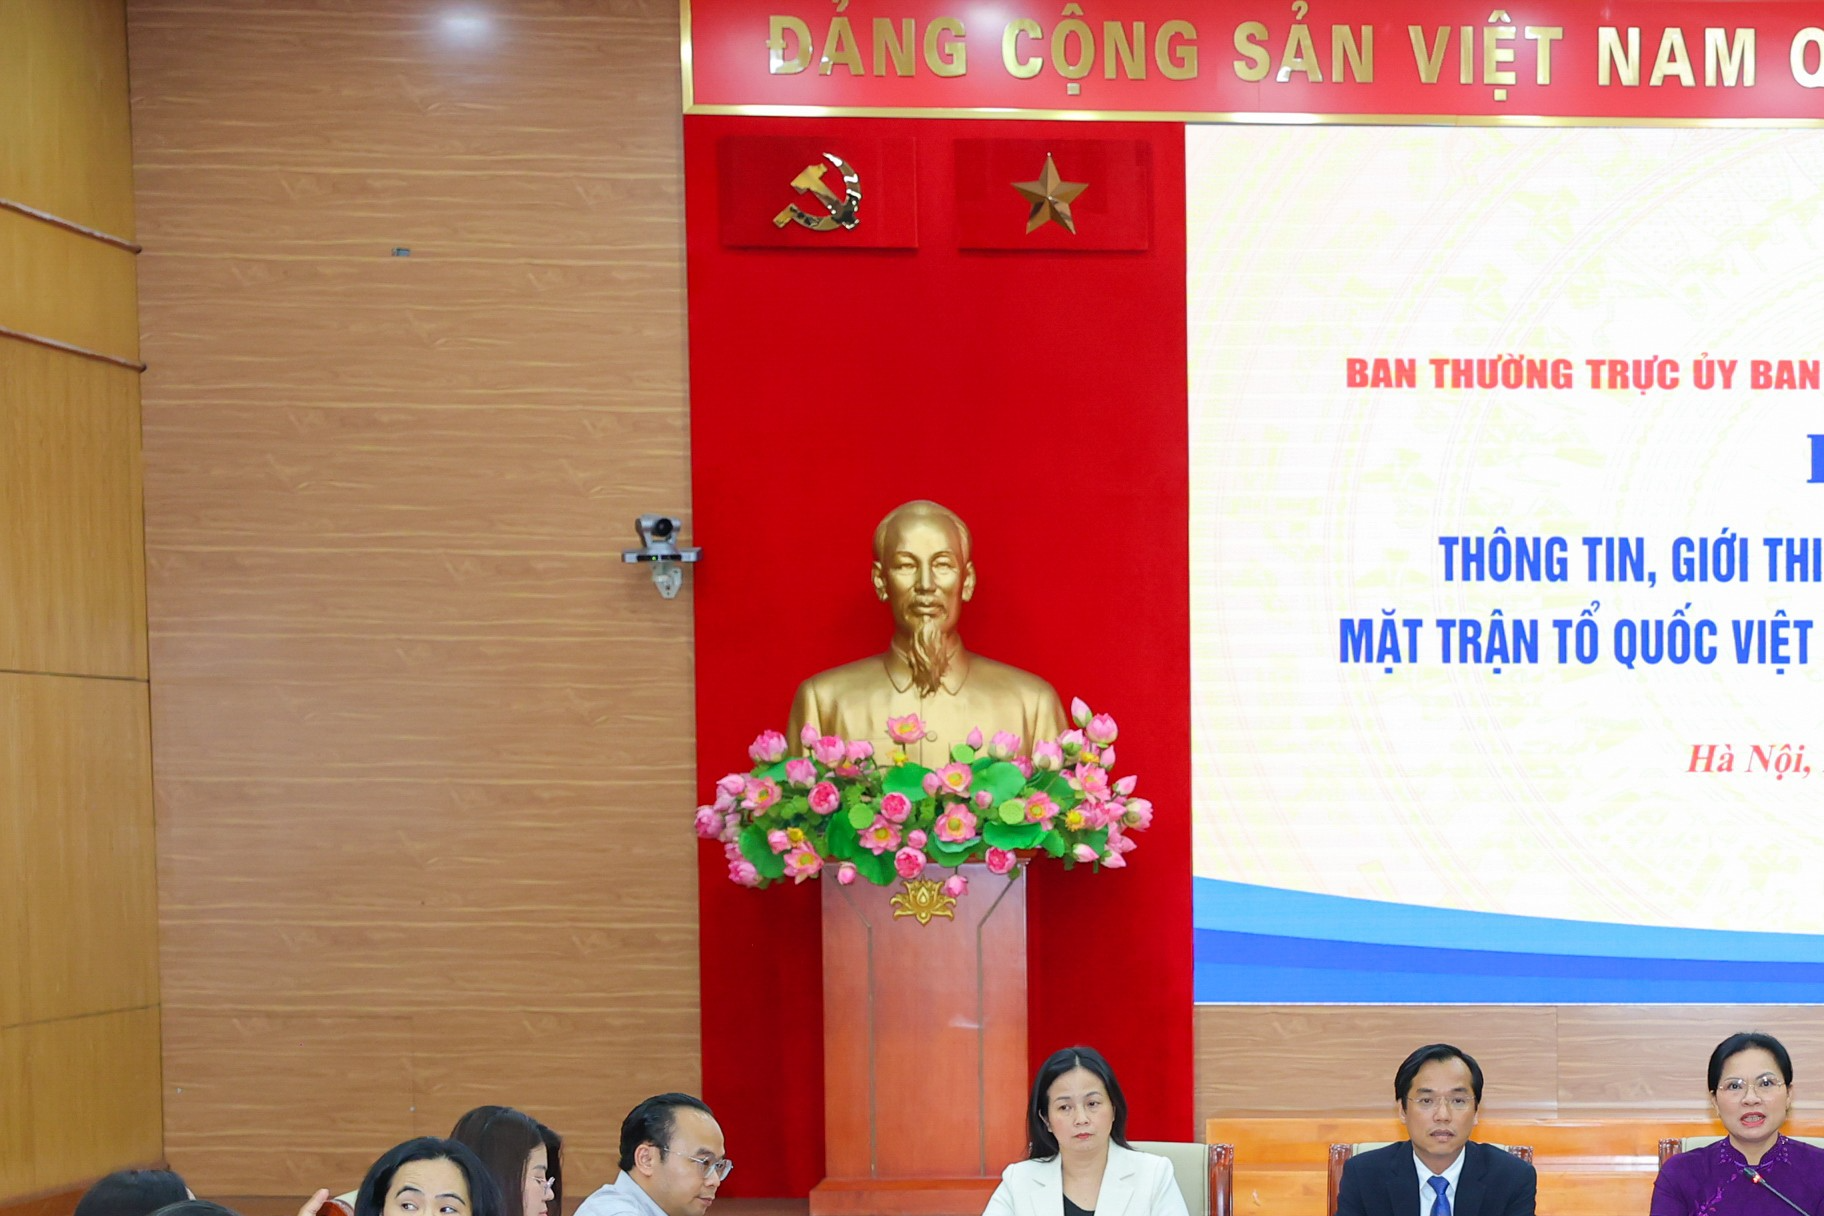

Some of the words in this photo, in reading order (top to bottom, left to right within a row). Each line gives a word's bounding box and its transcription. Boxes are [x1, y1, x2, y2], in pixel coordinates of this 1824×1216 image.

[766, 0, 967, 77] ĐẢNG
[1001, 3, 1199, 96] CỘNG
[1232, 0, 1374, 84] SẢN
[1407, 9, 1565, 102] VIỆT
[1597, 26, 1757, 87] NAM
[1346, 357, 1417, 389] BAN
[1429, 353, 1573, 390] THƯỜNG
[1585, 355, 1680, 396] TRỰC
[1693, 352, 1738, 390] ỦY
[1751, 359, 1821, 390] BAN
[1439, 526, 1568, 583] THÔNG
[1582, 536, 1657, 588] TIN,
[1672, 527, 1749, 583] GIỚI
[1340, 609, 1424, 675] MẶT
[1436, 609, 1539, 675] TRẬN
[1552, 600, 1601, 665] TỔ
[1614, 602, 1718, 670] QUỐC
[1731, 609, 1814, 675] VIỆT
[1687, 743, 1735, 773] Hà
[1749, 743, 1811, 781] Nội,
